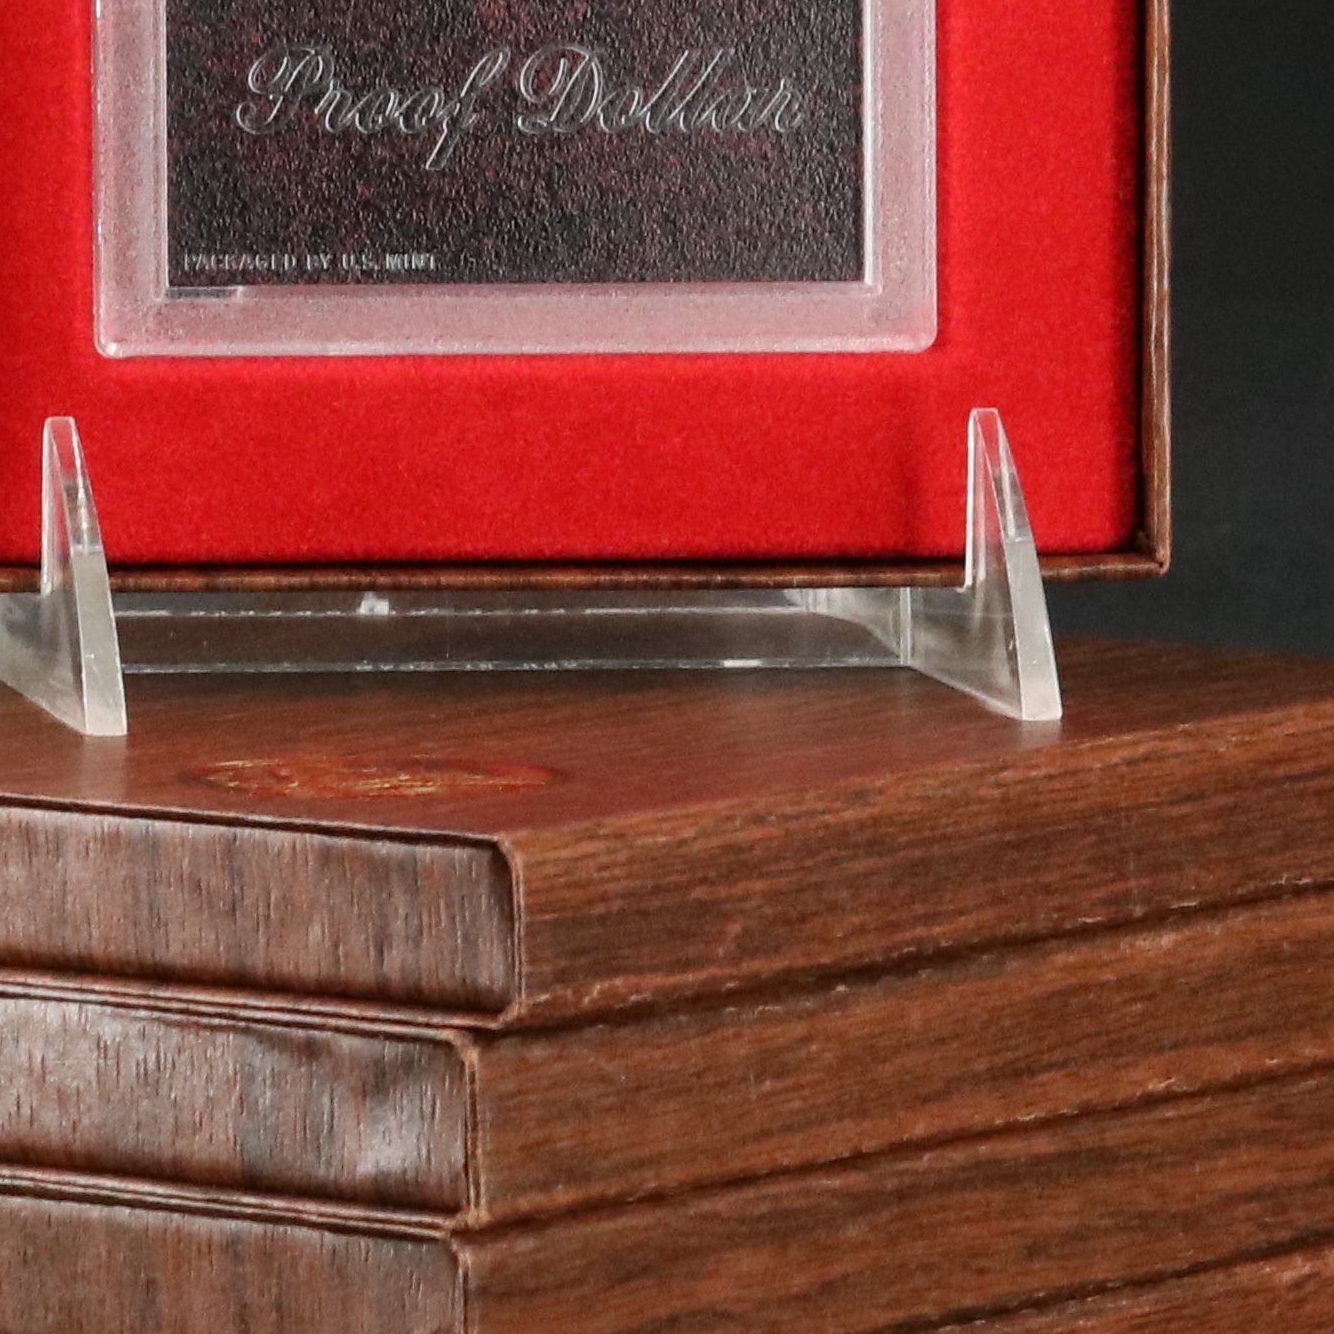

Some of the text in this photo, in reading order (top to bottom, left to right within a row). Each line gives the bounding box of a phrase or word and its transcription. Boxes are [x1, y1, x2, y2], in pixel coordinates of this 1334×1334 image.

[237, 45, 803, 171] Proof Dollar
[184, 254, 296, 270] PACKAGED
[306, 254, 331, 269] BY
[386, 253, 436, 269] MINT
